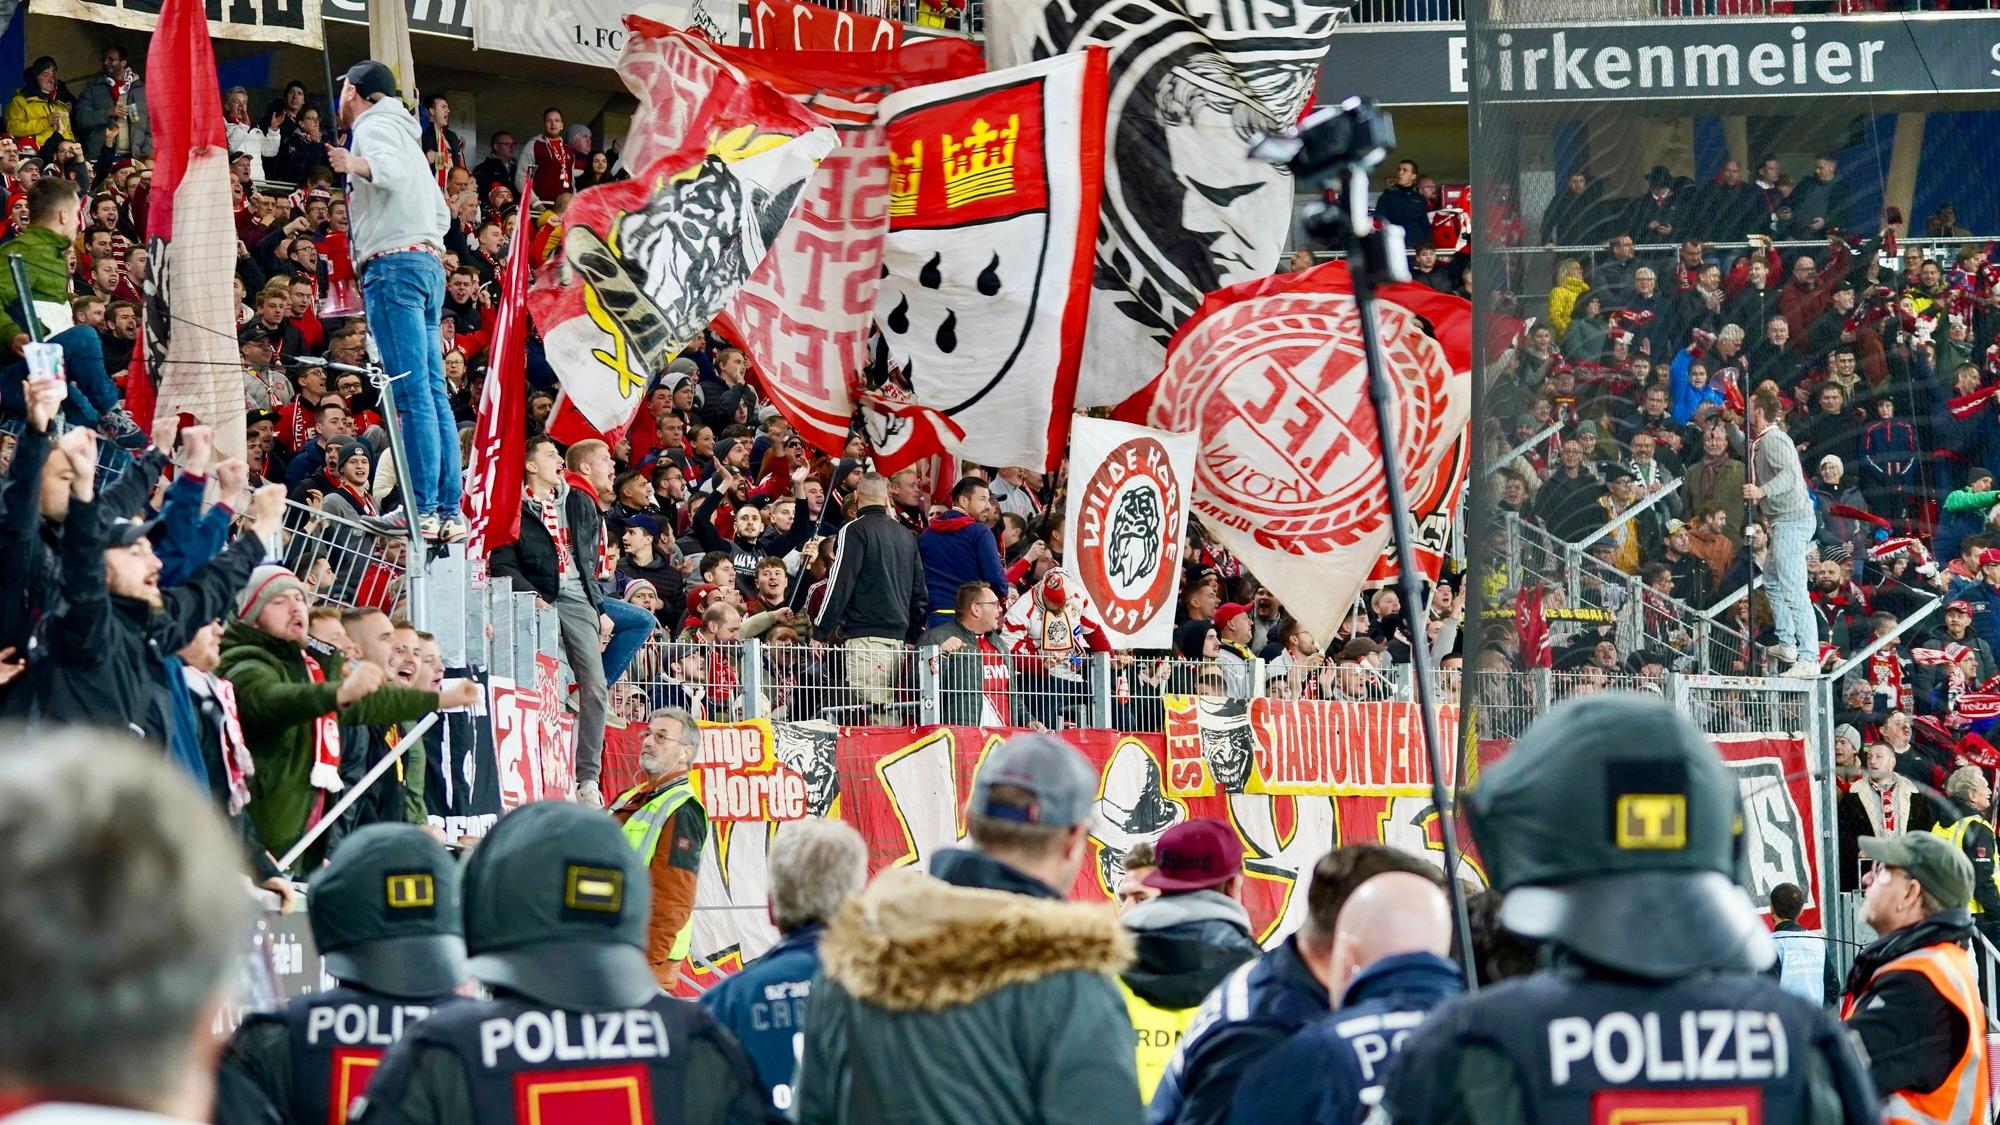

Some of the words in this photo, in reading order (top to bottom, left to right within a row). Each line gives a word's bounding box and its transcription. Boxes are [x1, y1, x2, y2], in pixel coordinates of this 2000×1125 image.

[574, 24, 590, 46] 1.
[594, 27, 624, 51] FC
[1449, 27, 1885, 93] Birkenmeier
[1084, 447, 1138, 548] WILDE
[1147, 446, 1178, 562] HORDE
[1105, 599, 1154, 630] 1996
[1251, 697, 1461, 787] STADIONVERO
[705, 764, 805, 818] Horde
[307, 1003, 433, 1046] POLI
[480, 1009, 670, 1068] POLIZEI
[1548, 1011, 1788, 1085] POLIZEI
